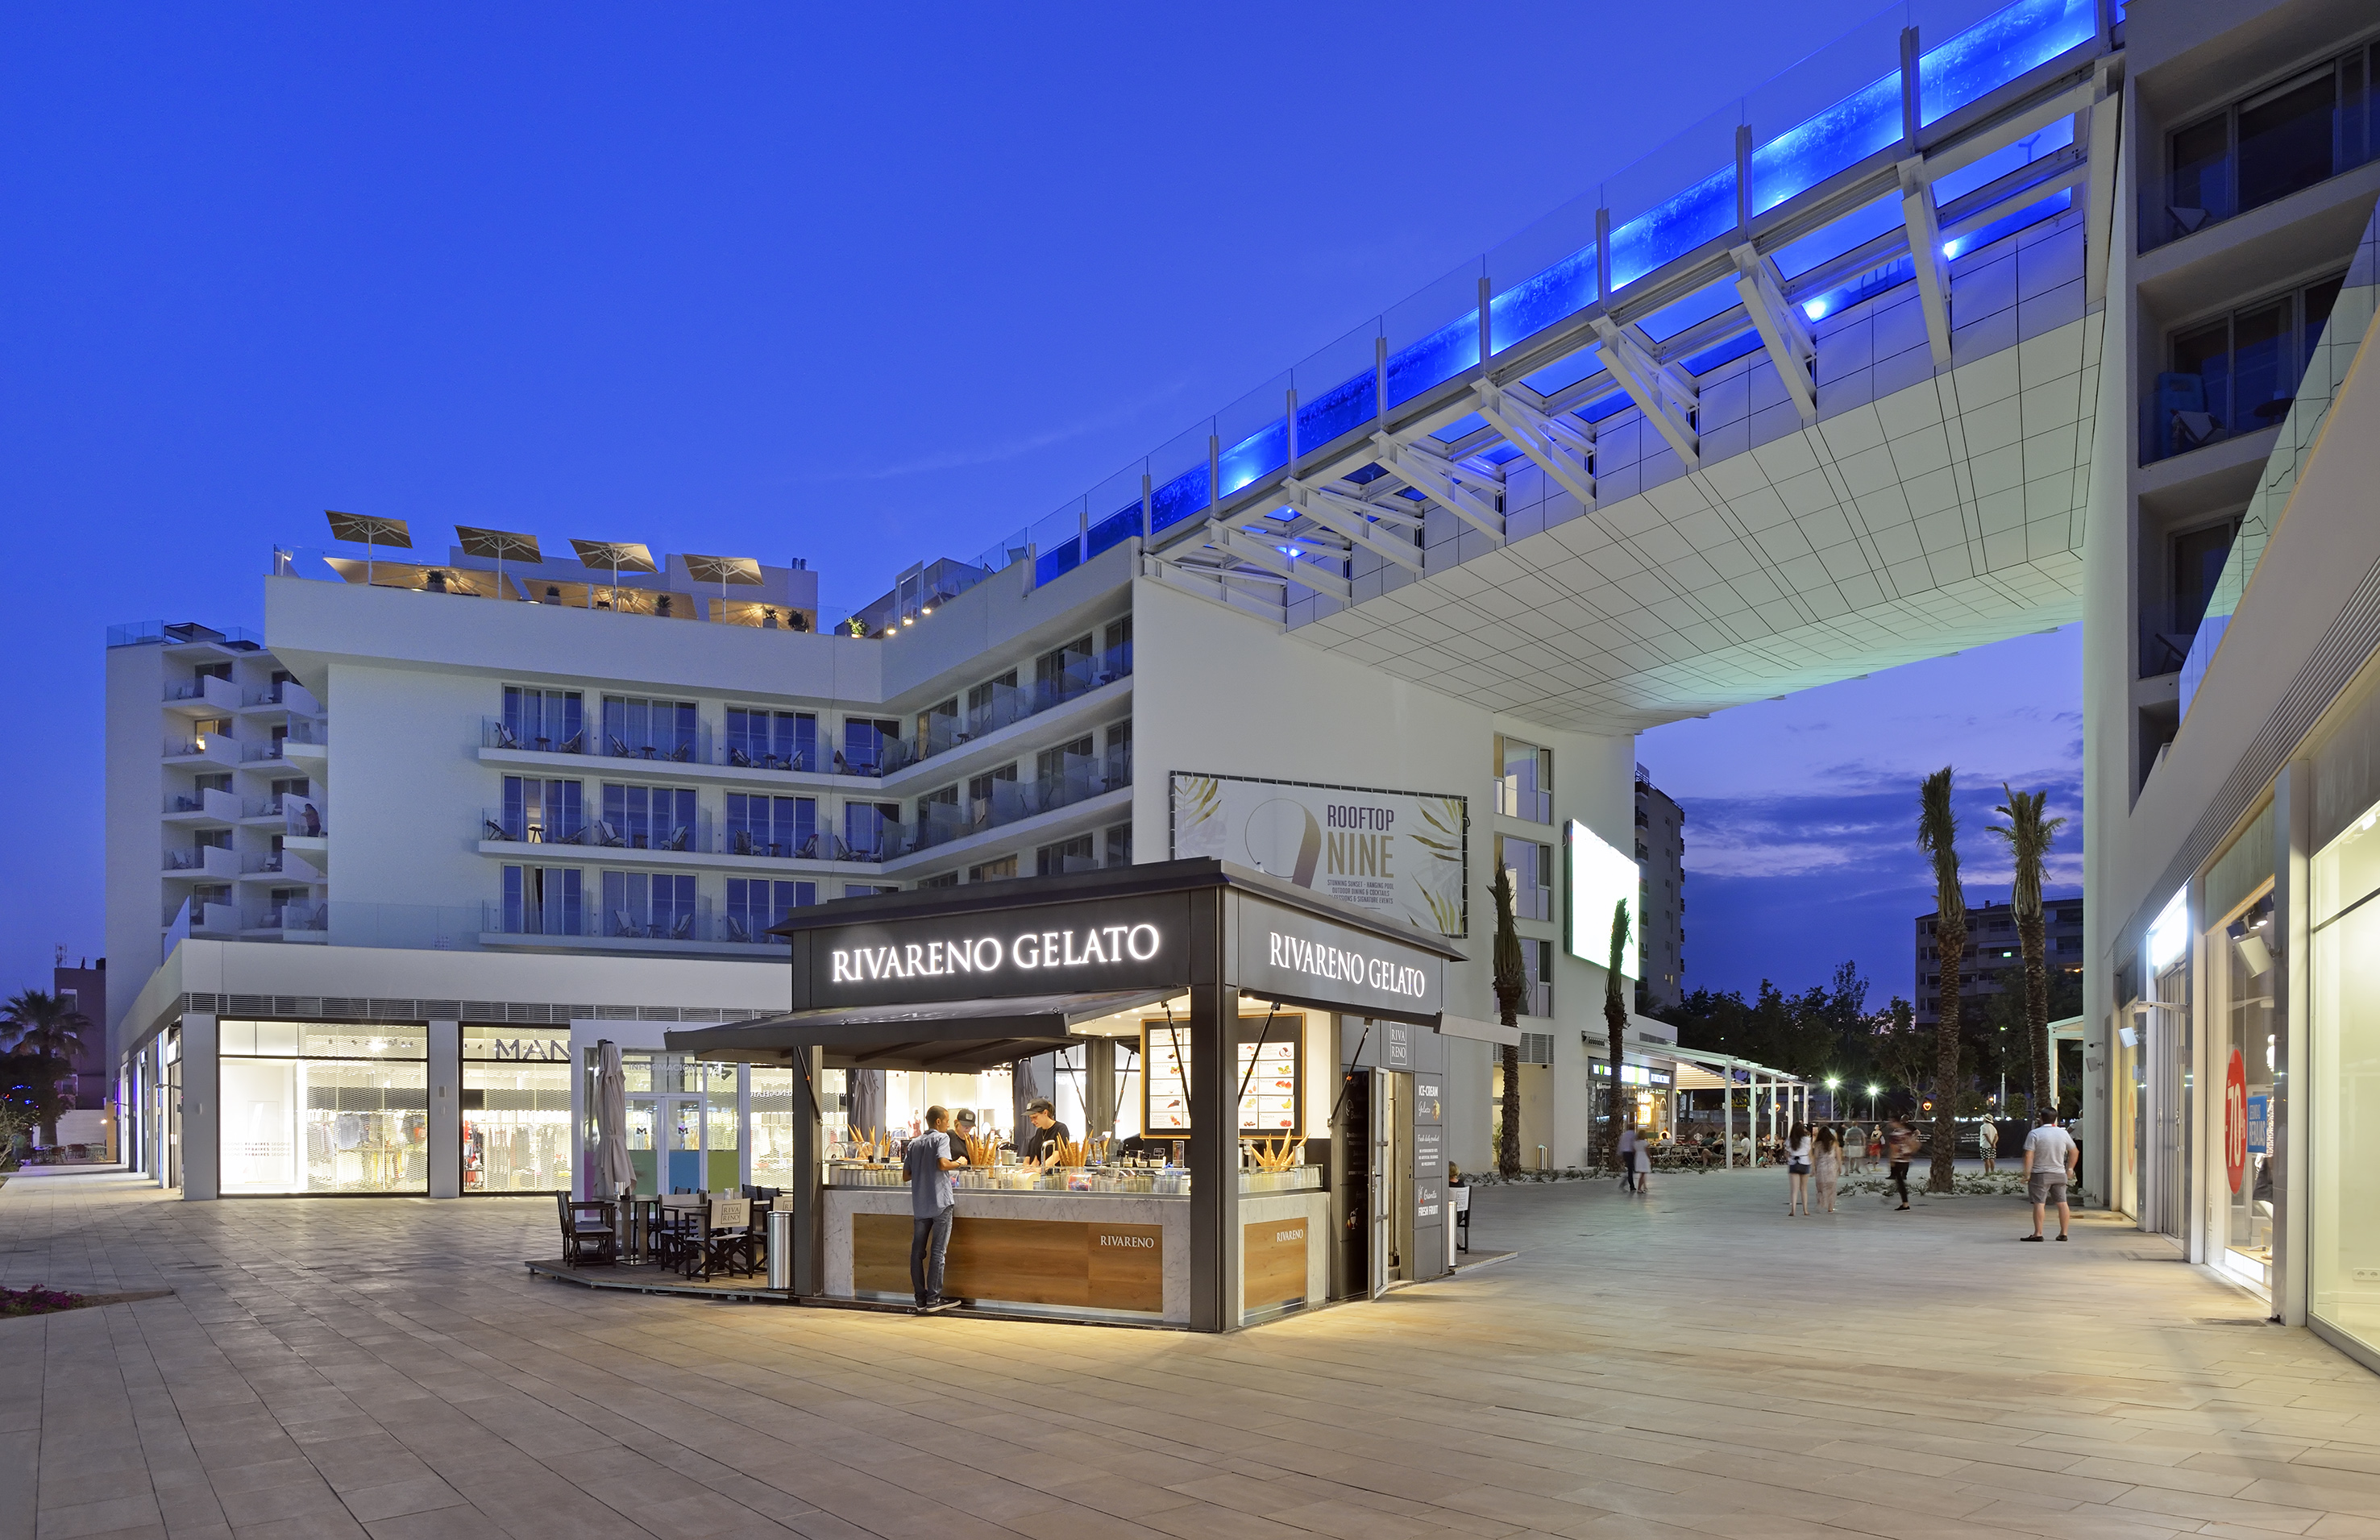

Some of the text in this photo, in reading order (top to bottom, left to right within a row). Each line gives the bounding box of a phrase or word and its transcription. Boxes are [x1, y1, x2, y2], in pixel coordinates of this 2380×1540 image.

[1327, 804, 1394, 831] ROOFTOP
[1327, 831, 1394, 878] NINE
[832, 924, 1160, 982] RIVARENO GELATO
[1269, 932, 1425, 998] RIVARENO GELATO
[1391, 1028, 1406, 1041] RIVA
[1391, 1045, 1406, 1058] RENO
[1418, 1085, 1439, 1097] ICE-CREAM
[2249, 1120, 2266, 1147] REBAJAS
[1418, 1205, 1439, 1217] FRESH FRUIT
[1100, 1235, 1154, 1248] RIVARENO
[1276, 1229, 1304, 1243] RIVARENO
